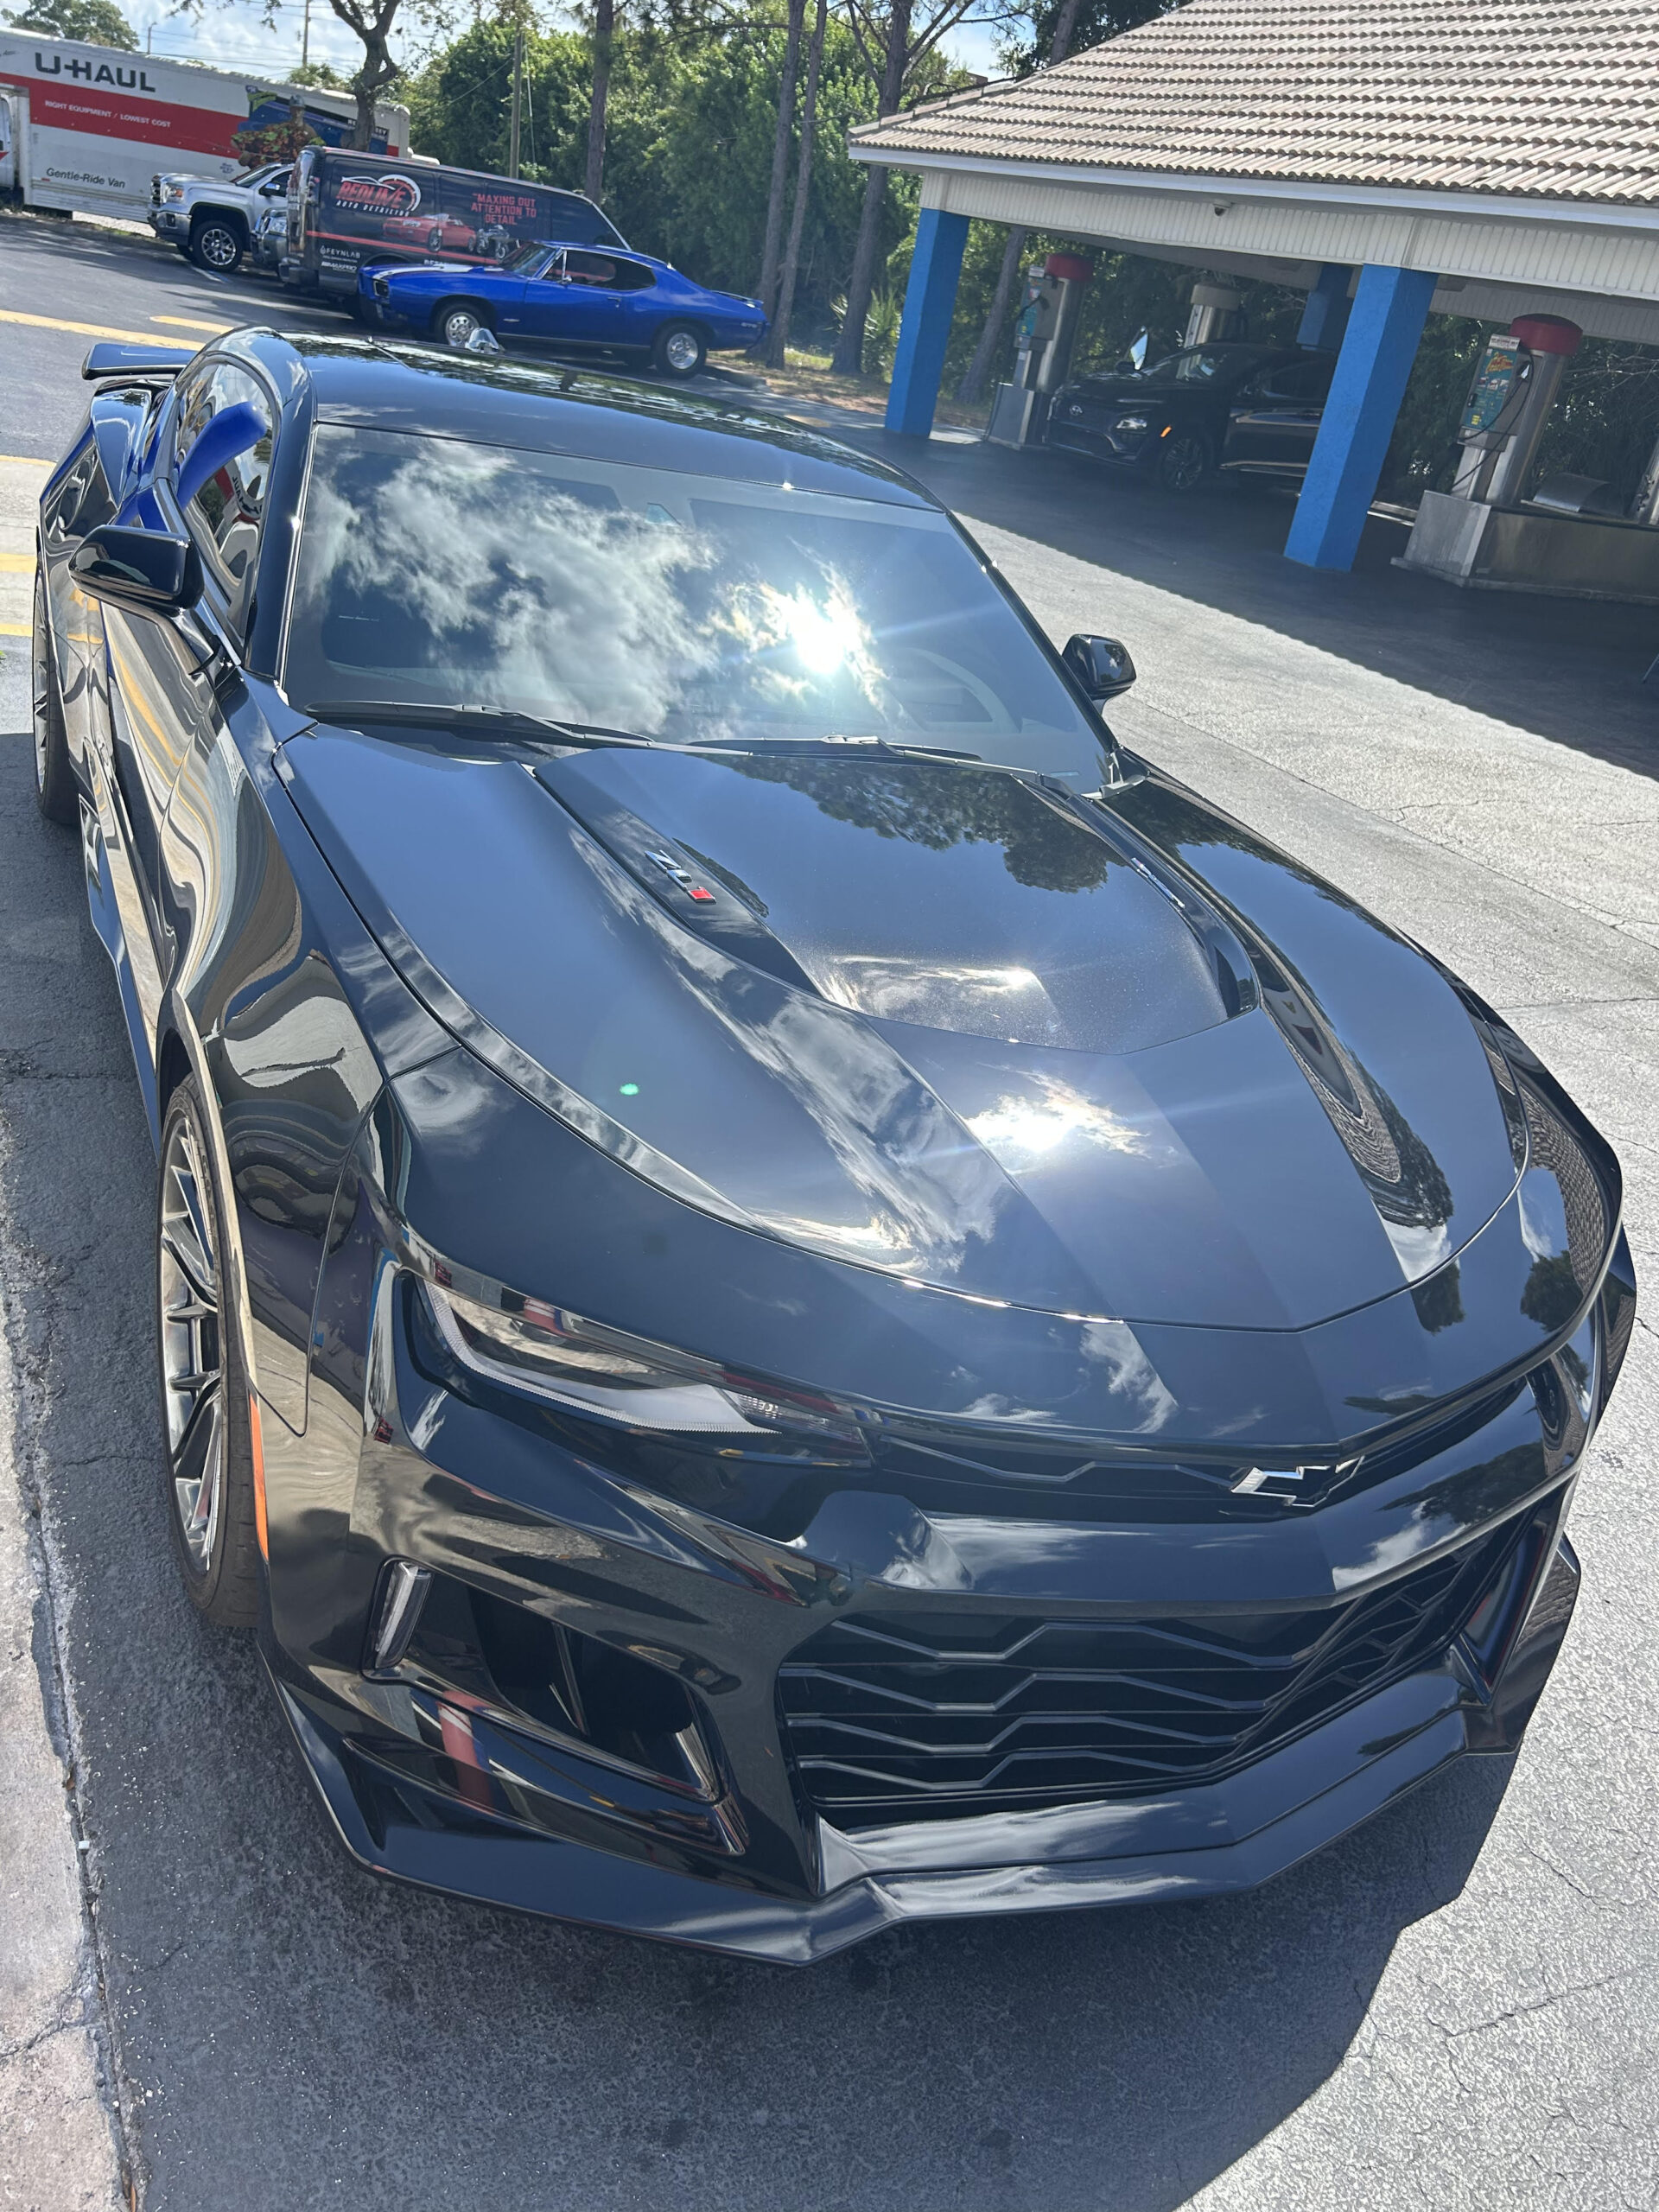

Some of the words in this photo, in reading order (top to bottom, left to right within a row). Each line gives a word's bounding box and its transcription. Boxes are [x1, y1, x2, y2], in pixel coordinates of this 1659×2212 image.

[35, 52, 156, 93] U-HAUL
[45, 99, 67, 111] RIGHT
[68, 104, 112, 118] EQUIPMENT
[119, 113, 150, 124] LOWEST
[151, 118, 171, 128] COST
[46, 168, 105, 185] Gentle-Ride
[107, 177, 125, 188] Van
[335, 181, 406, 209] REDLINE
[518, 196, 537, 208] OUT
[336, 200, 359, 209] AUTO
[363, 204, 410, 218] DETAILING
[470, 202, 523, 216] ATTENTION
[525, 207, 537, 218] TO
[326, 247, 360, 258] FEYNLAB
[645, 849, 717, 906] ZL1
